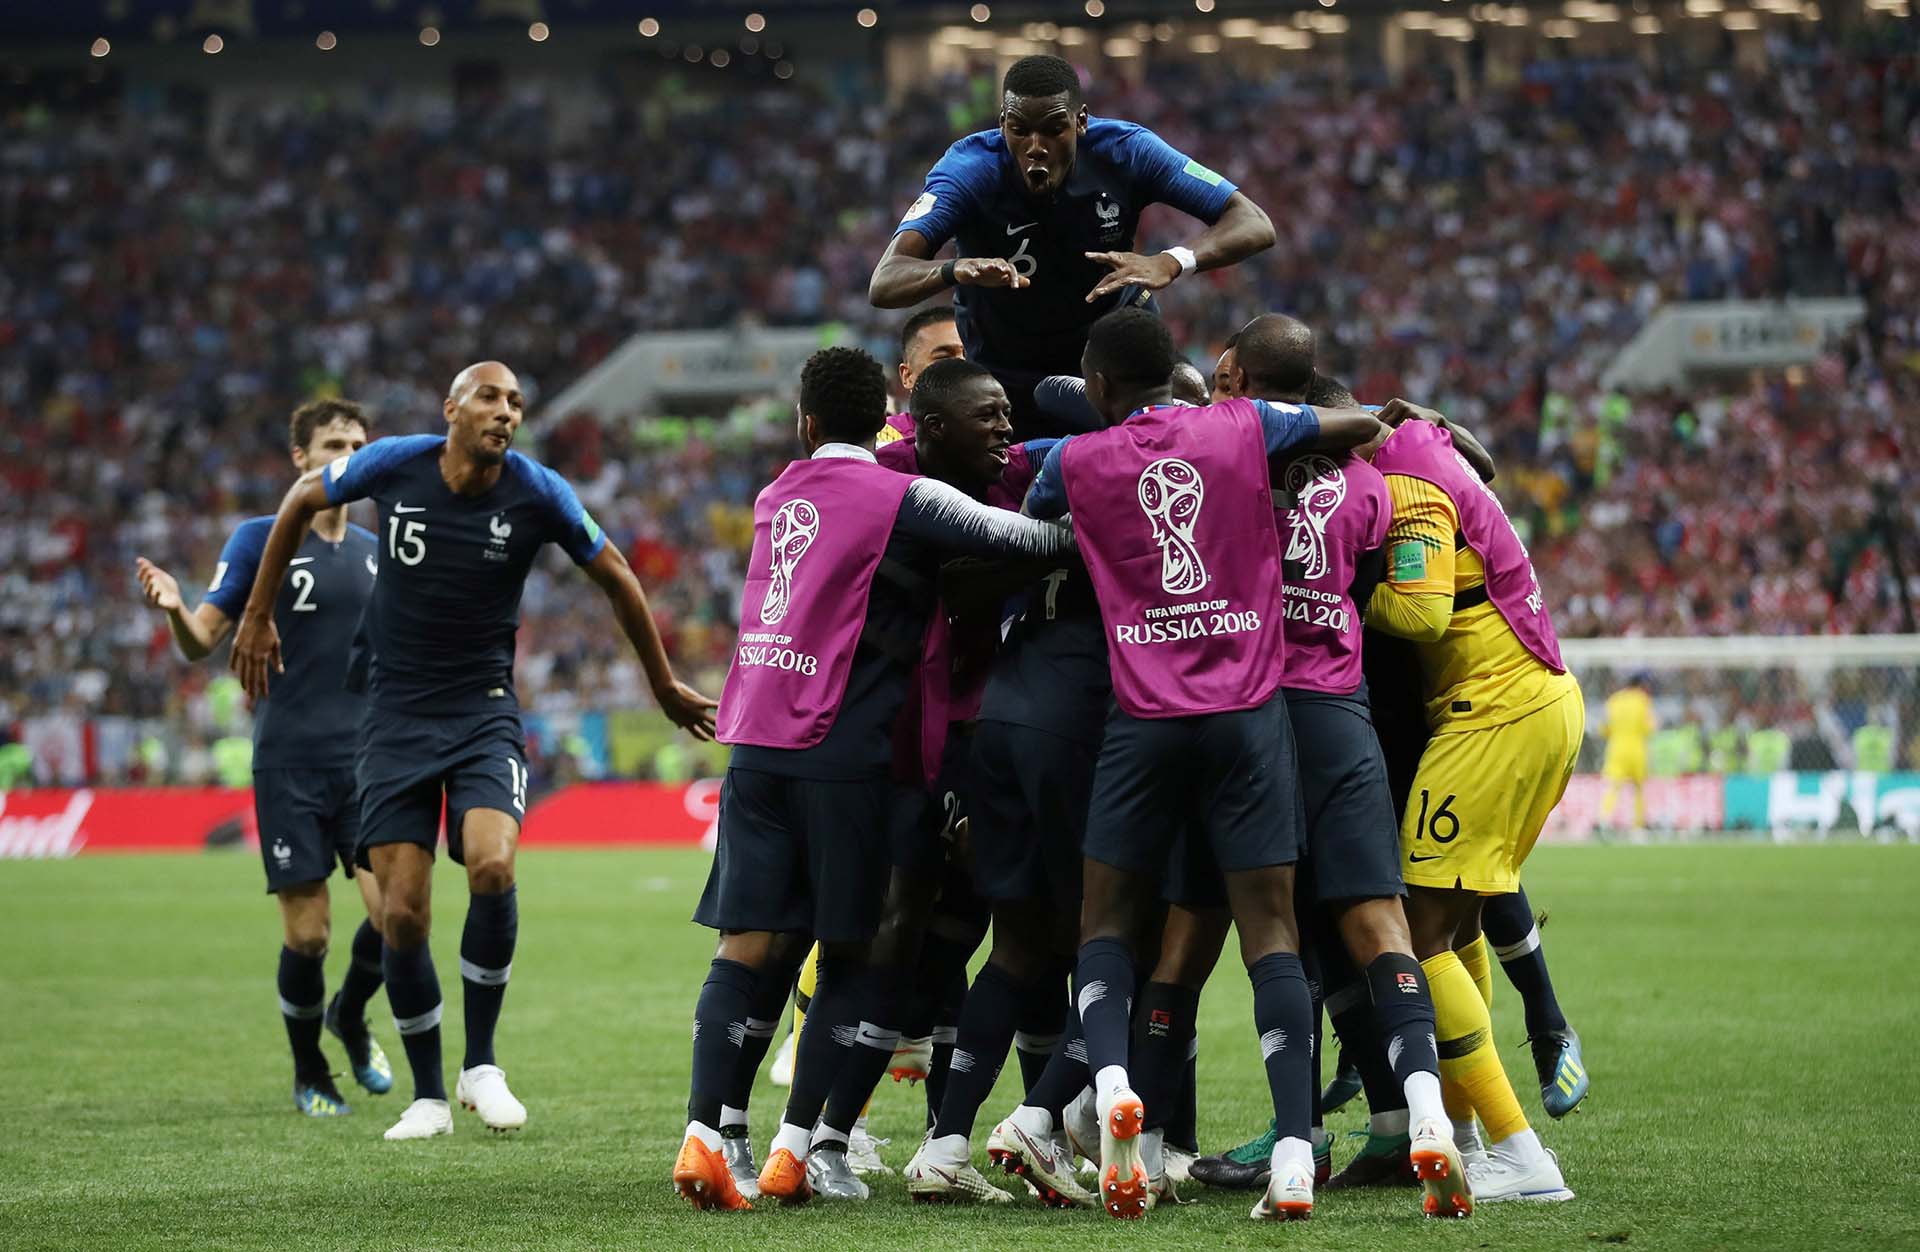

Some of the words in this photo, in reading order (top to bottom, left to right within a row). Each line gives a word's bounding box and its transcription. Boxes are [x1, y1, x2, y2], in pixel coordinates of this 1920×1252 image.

[1008, 239, 1037, 277] 6
[389, 516, 427, 566] 15
[291, 569, 318, 611] 2
[1281, 585, 1320, 600] WORLD
[1320, 592, 1342, 604] CUP
[1145, 607, 1169, 619] FIFA
[1168, 601, 1209, 616] WORLD
[1210, 599, 1229, 610] CUP
[775, 634, 793, 645] CUP
[1116, 617, 1209, 645] RUSSIA
[1209, 610, 1261, 636] 2018
[738, 645, 767, 665] SSIA
[765, 647, 818, 676] 2018
[1416, 789, 1460, 843] 16
